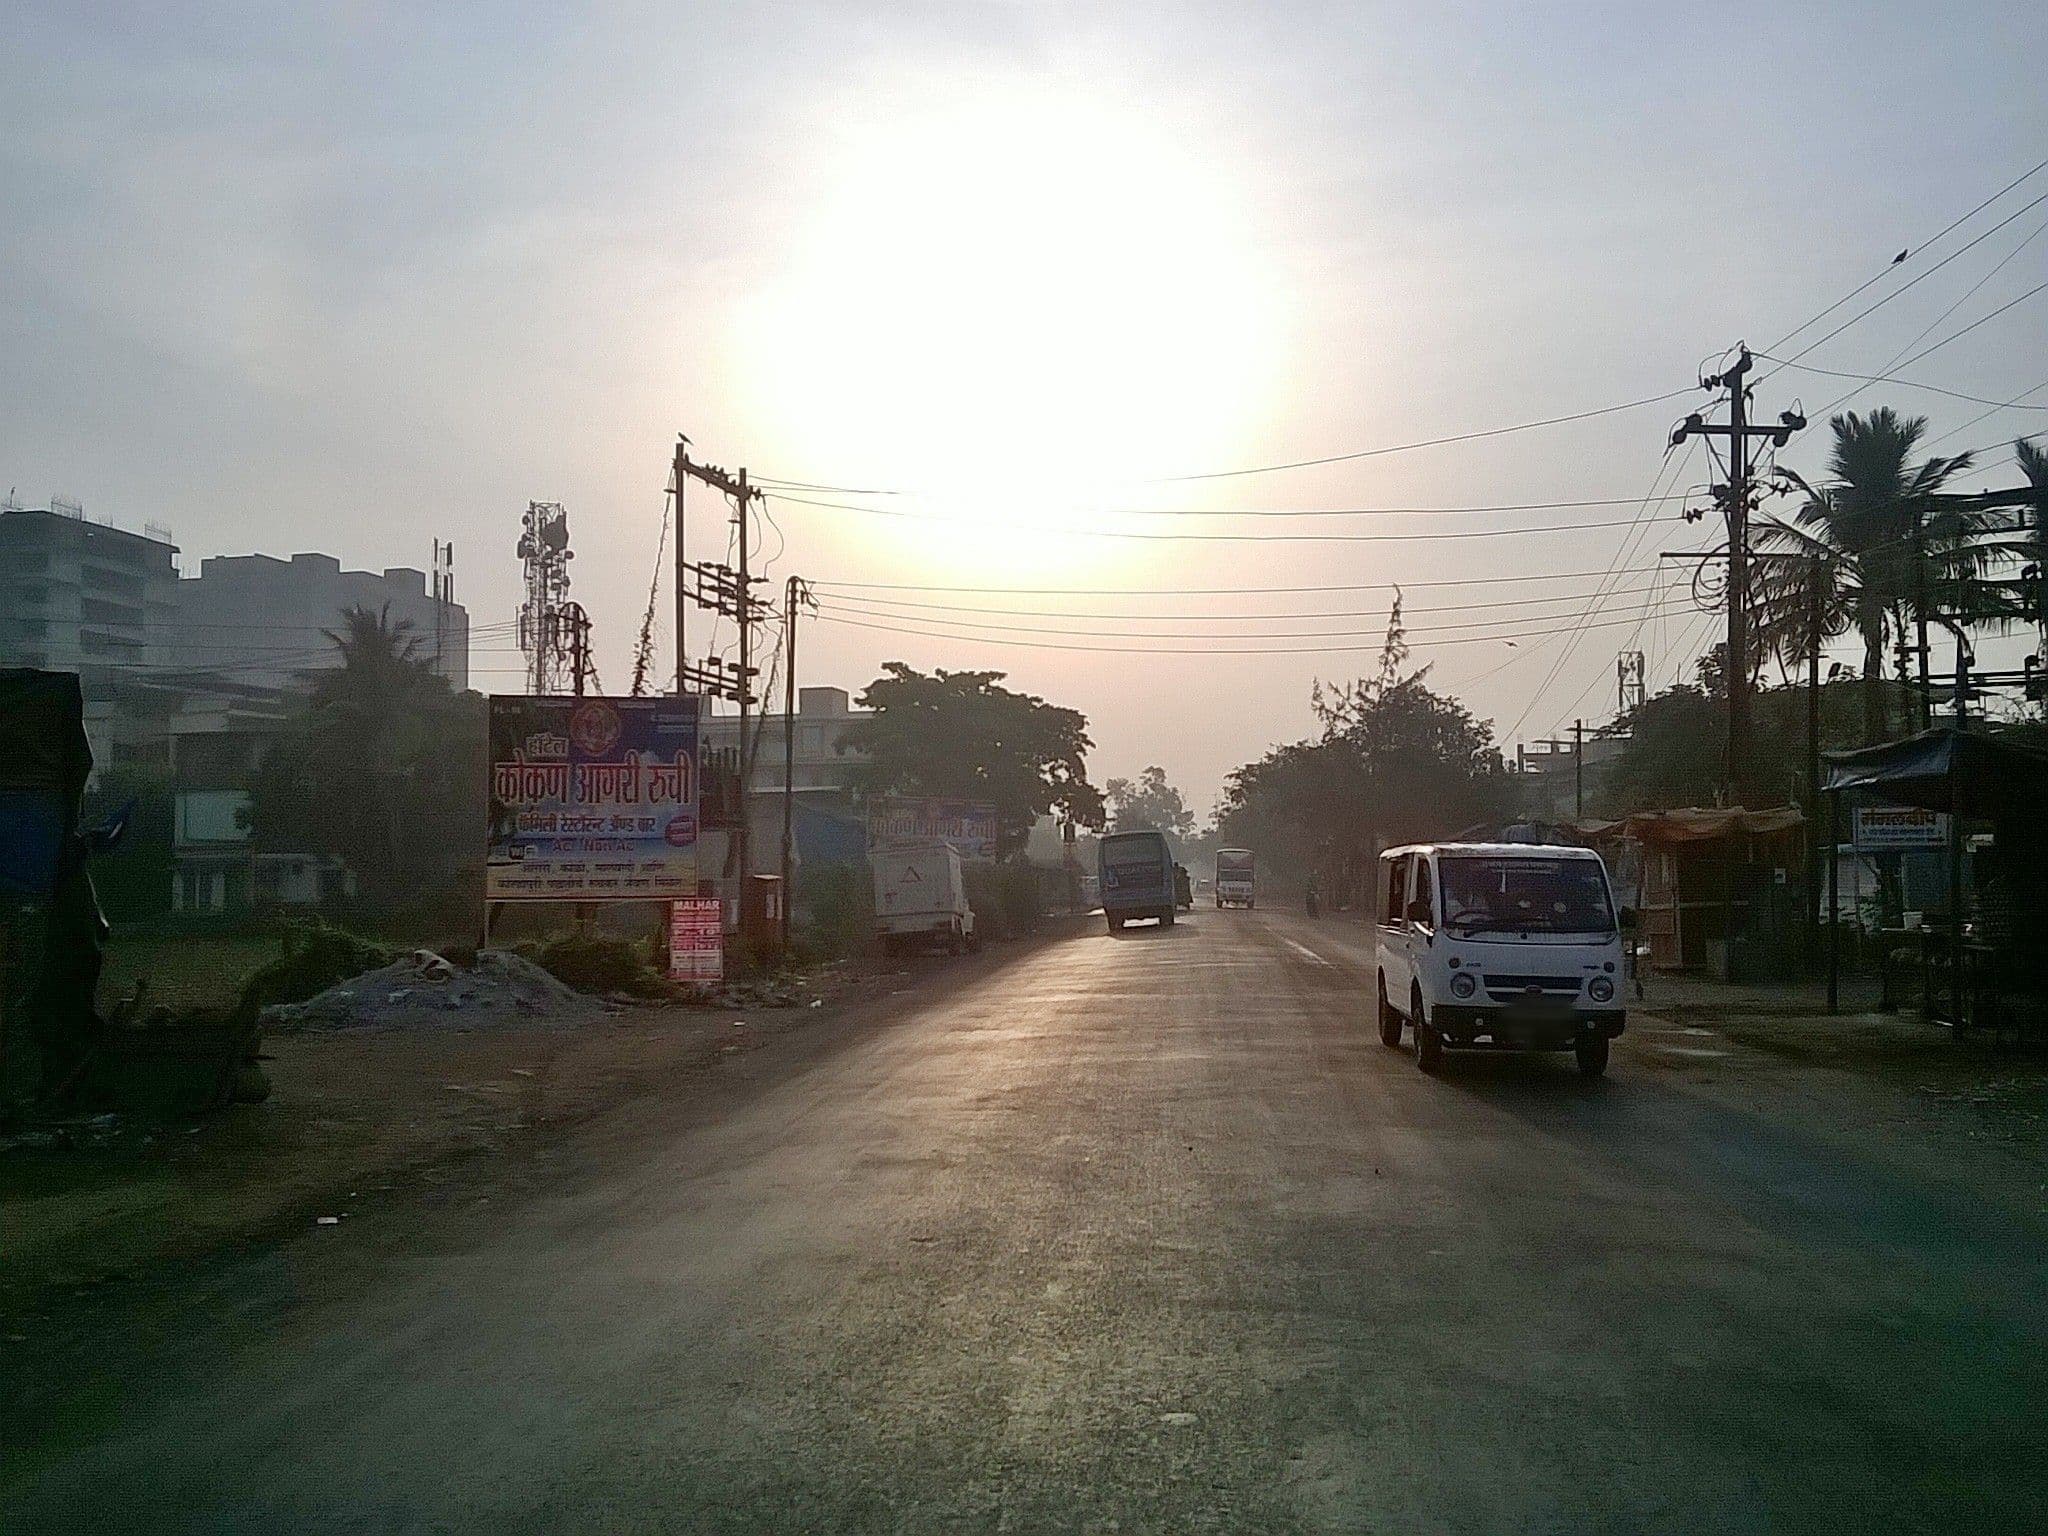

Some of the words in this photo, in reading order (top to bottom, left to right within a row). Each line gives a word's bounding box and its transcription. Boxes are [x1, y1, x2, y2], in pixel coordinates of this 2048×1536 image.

[527, 735, 569, 756] हॉटेल
[495, 748, 569, 804] कोकण
[575, 748, 641, 804] आगरी
[647, 748, 692, 804] रुची
[673, 900, 720, 911] MALHAR
